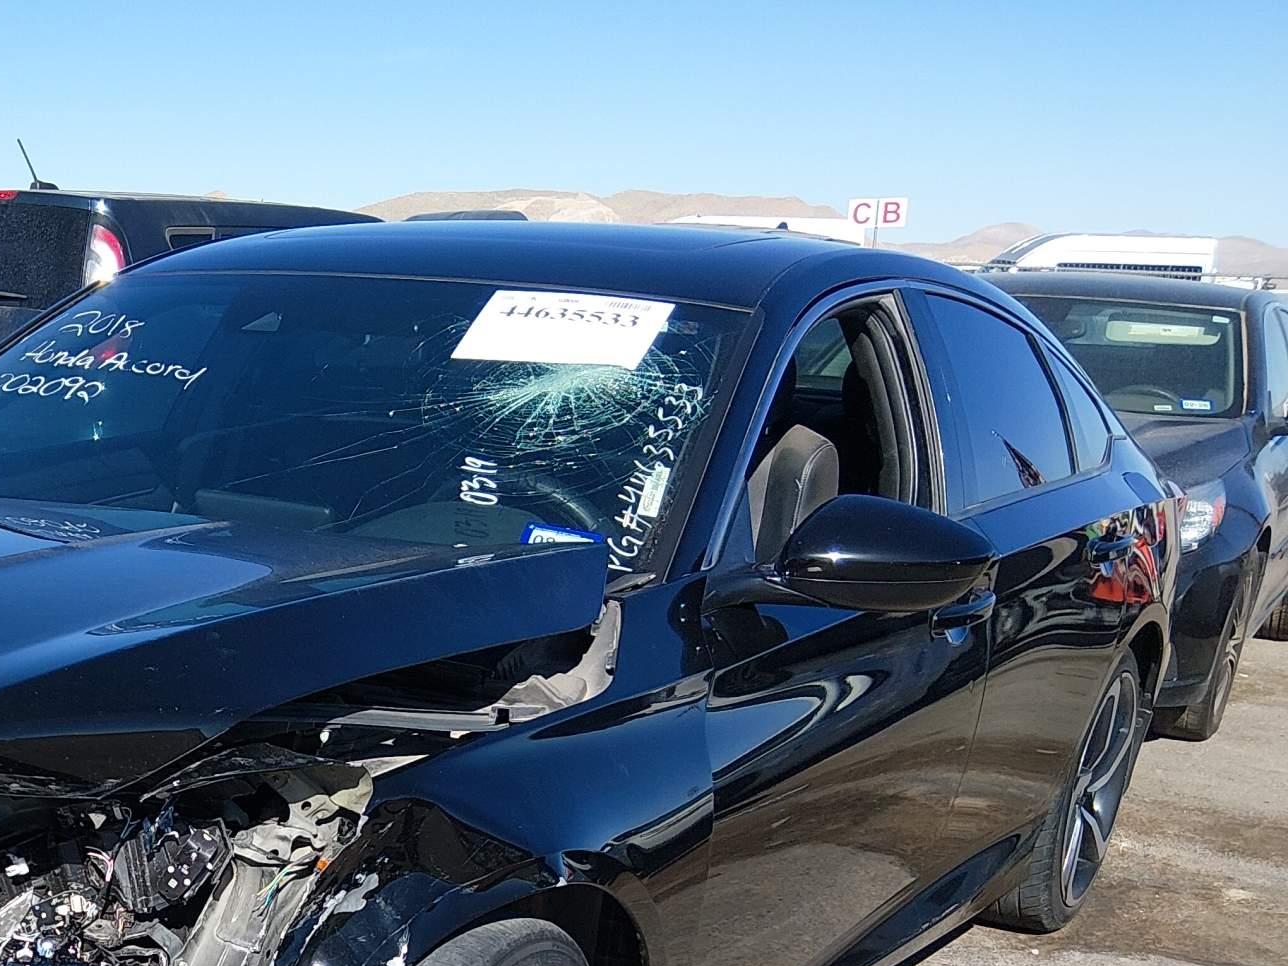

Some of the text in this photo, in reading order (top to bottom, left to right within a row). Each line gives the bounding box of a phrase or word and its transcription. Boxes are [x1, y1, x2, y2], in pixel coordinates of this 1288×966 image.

[852, 201, 901, 225] C B
[59, 310, 145, 339] 2018
[499, 304, 641, 328] 44635533
[20, 340, 95, 370] Honda
